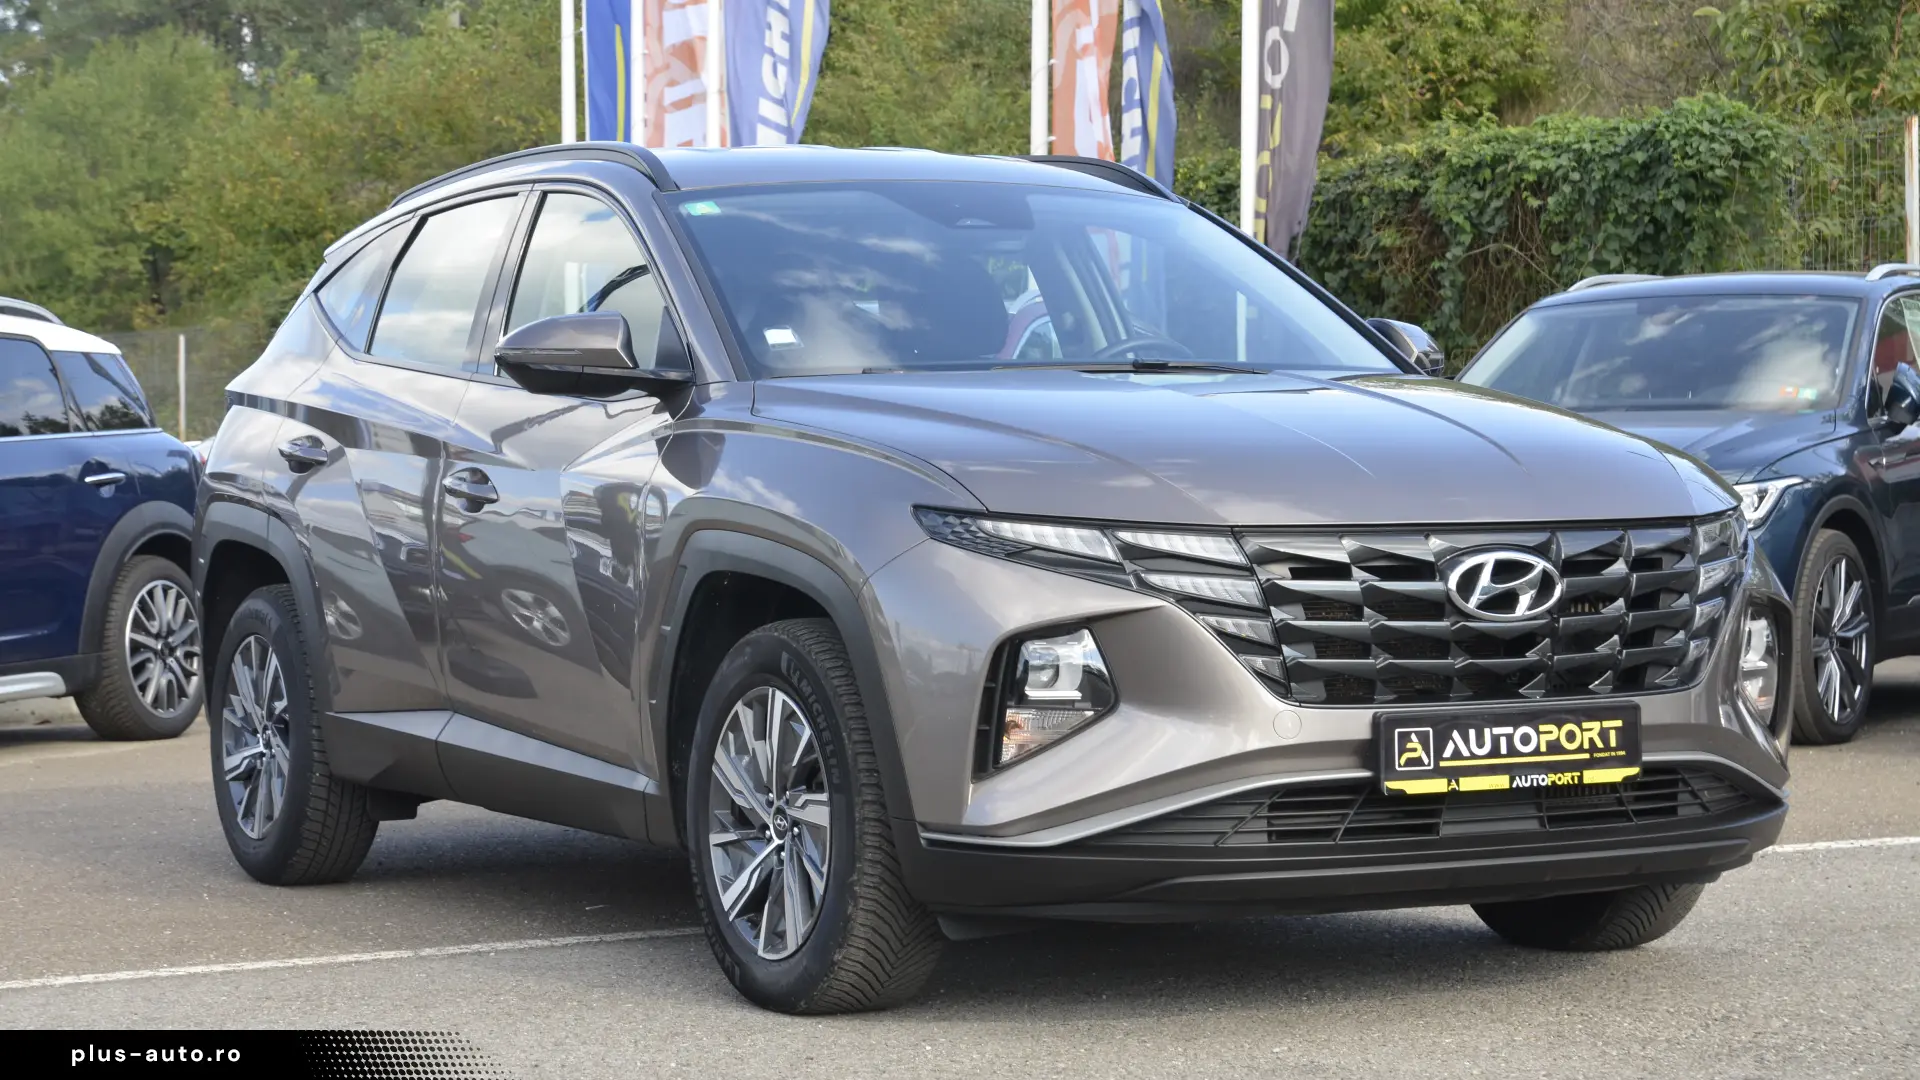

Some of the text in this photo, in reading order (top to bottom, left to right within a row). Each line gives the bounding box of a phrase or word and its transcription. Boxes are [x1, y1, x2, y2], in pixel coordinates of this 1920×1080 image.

[756, 0, 791, 145] ICH
[799, 678, 841, 785] MICHELIN
[1442, 720, 1623, 758] AUTOPORT
[1512, 772, 1581, 788] AUTOPORT
